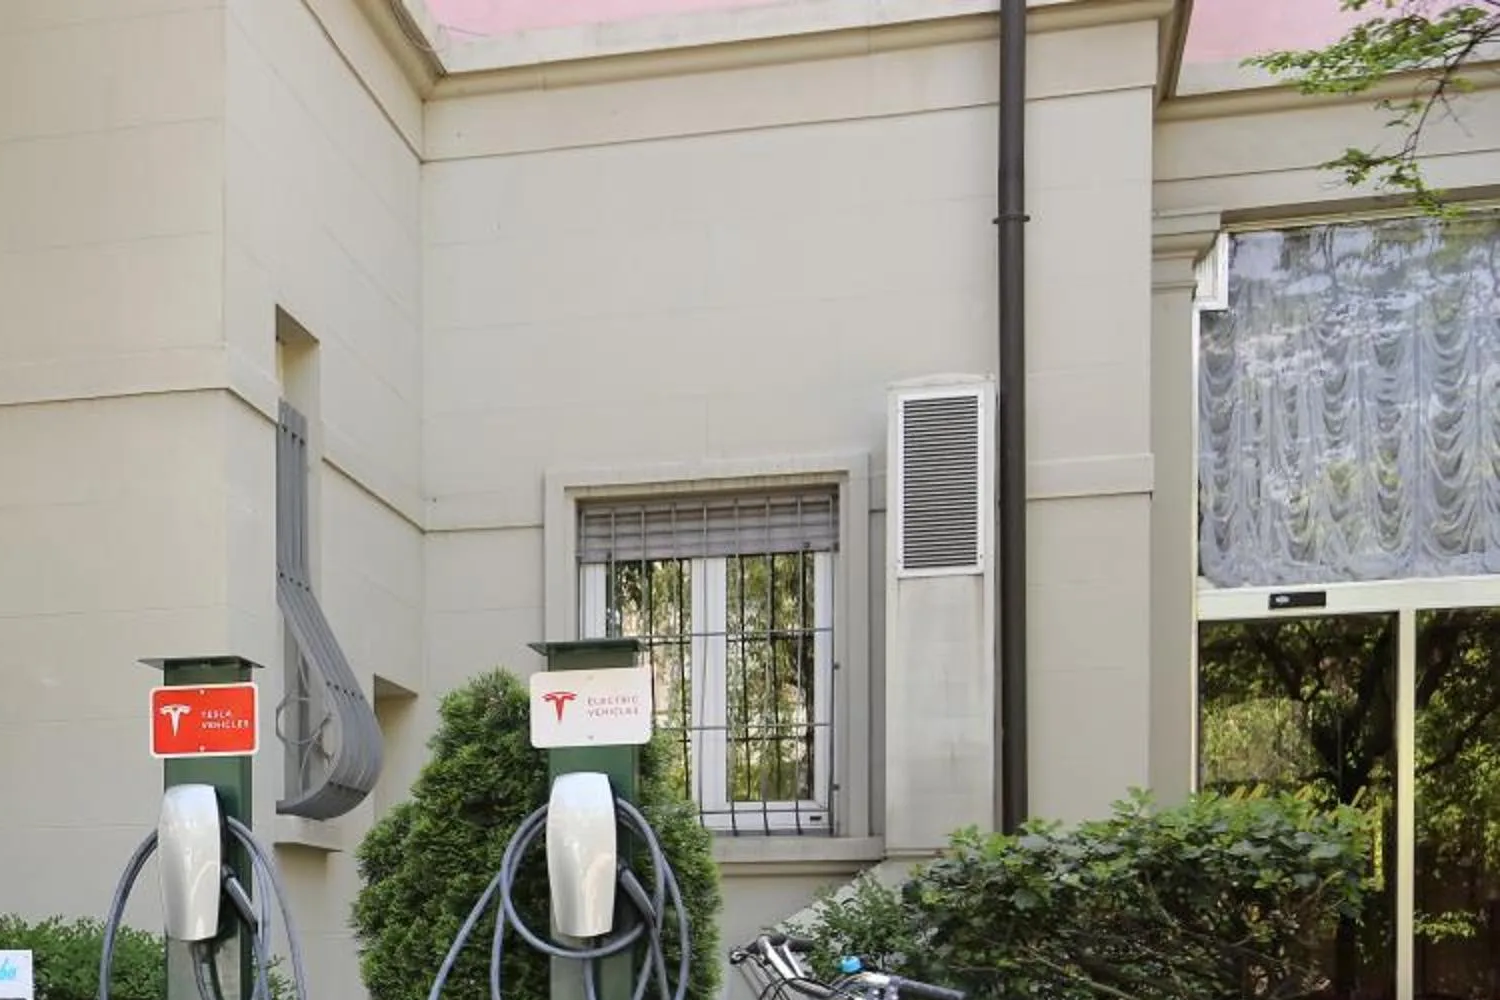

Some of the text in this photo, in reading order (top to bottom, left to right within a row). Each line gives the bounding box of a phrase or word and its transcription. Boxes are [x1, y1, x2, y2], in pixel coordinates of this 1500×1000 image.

[587, 696, 638, 706] ELECTRIC
[201, 709, 232, 719] TESLA
[587, 706, 638, 717] VEHICLES
[201, 719, 249, 729] VEHICLES
